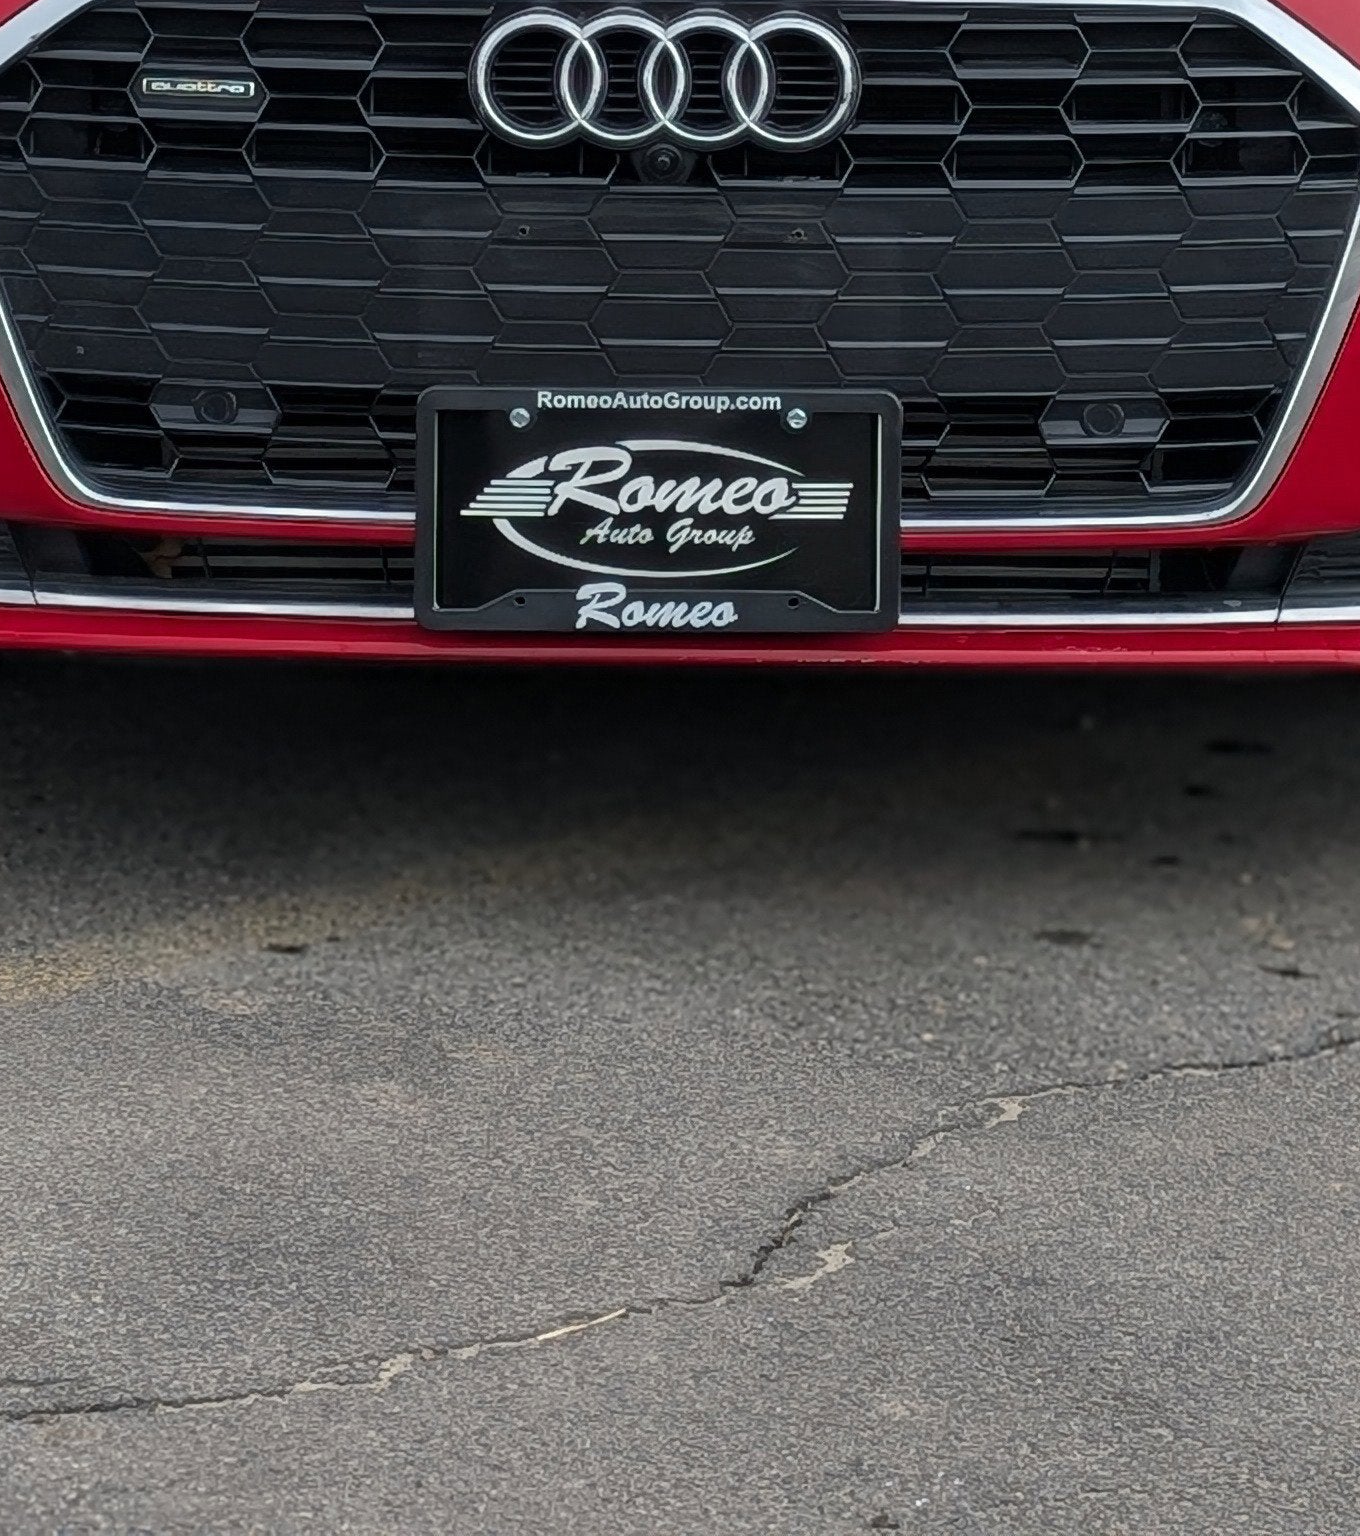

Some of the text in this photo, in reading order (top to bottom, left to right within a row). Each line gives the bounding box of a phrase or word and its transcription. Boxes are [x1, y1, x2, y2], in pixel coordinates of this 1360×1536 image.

[536, 390, 782, 414] RomeoAutoGroup.com
[547, 445, 797, 517] Romeo
[579, 517, 756, 554] Auto Group
[574, 580, 739, 630] Romeo
